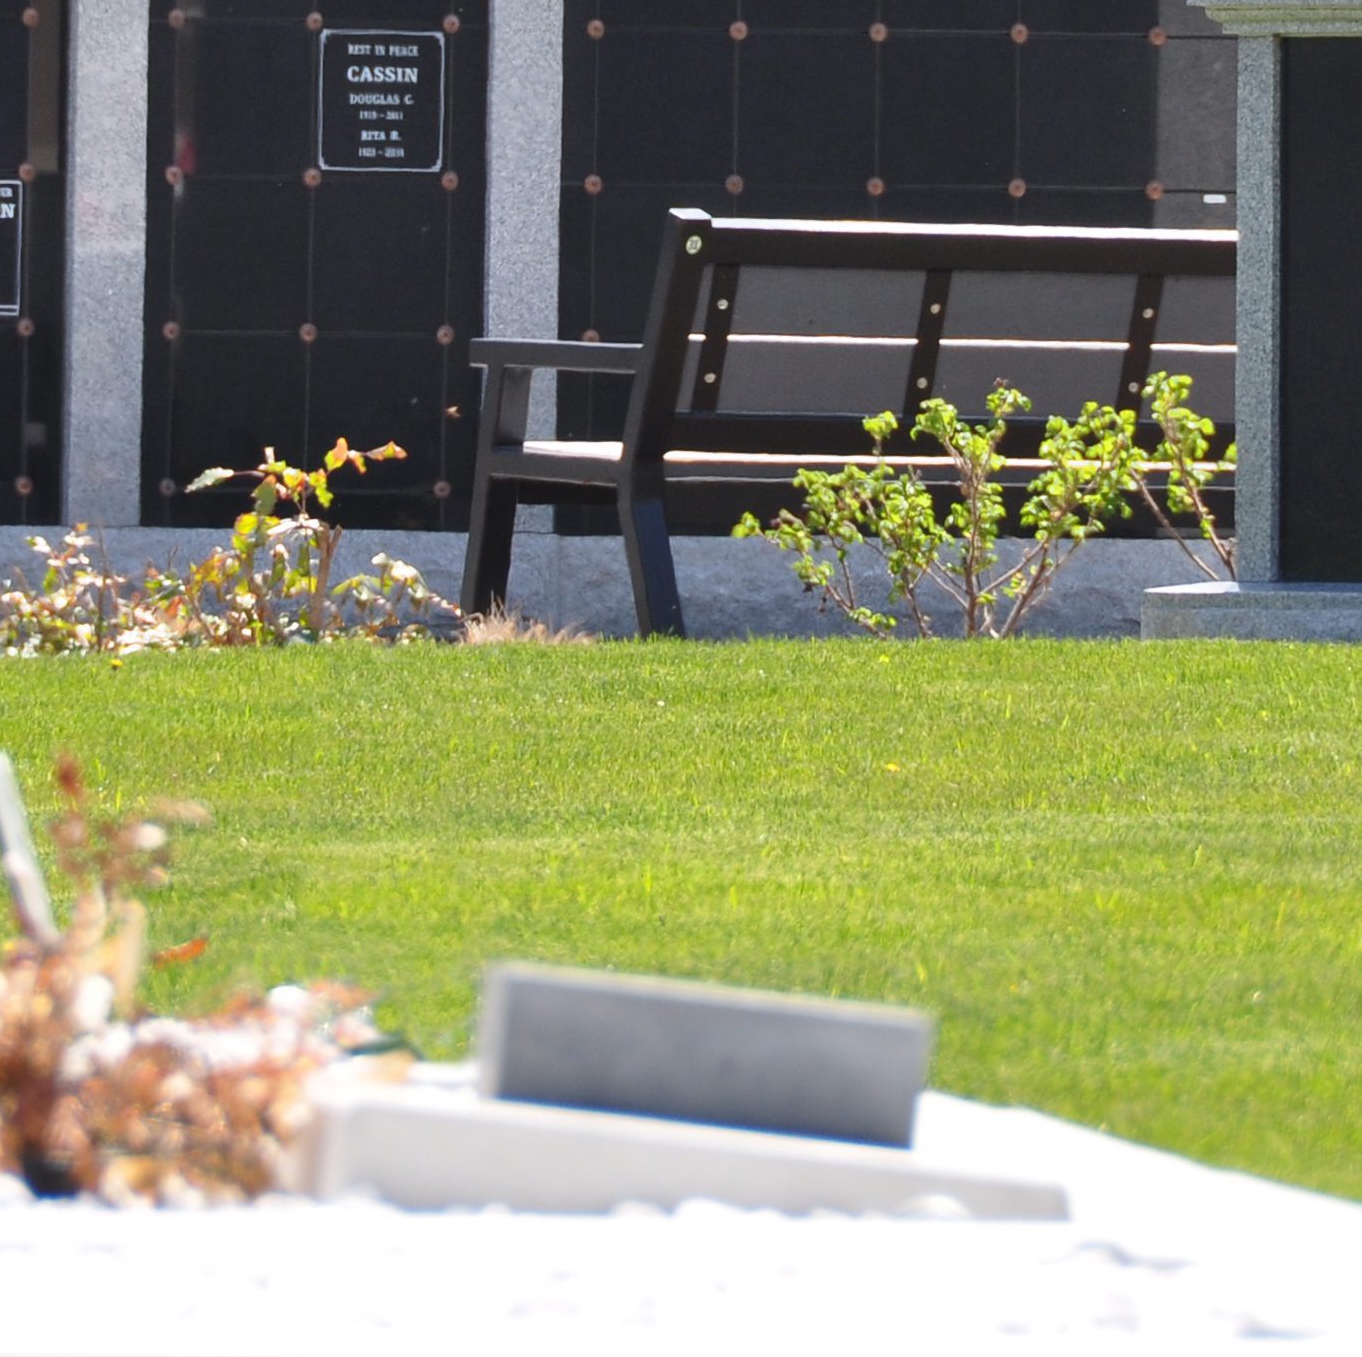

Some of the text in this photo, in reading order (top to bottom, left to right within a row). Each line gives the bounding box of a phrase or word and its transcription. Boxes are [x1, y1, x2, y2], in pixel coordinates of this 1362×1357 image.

[348, 44, 419, 57] REST IN PEACE
[347, 66, 419, 84] CASSIN
[349, 93, 400, 106] DOUGLAS
[361, 130, 386, 141] RITA
